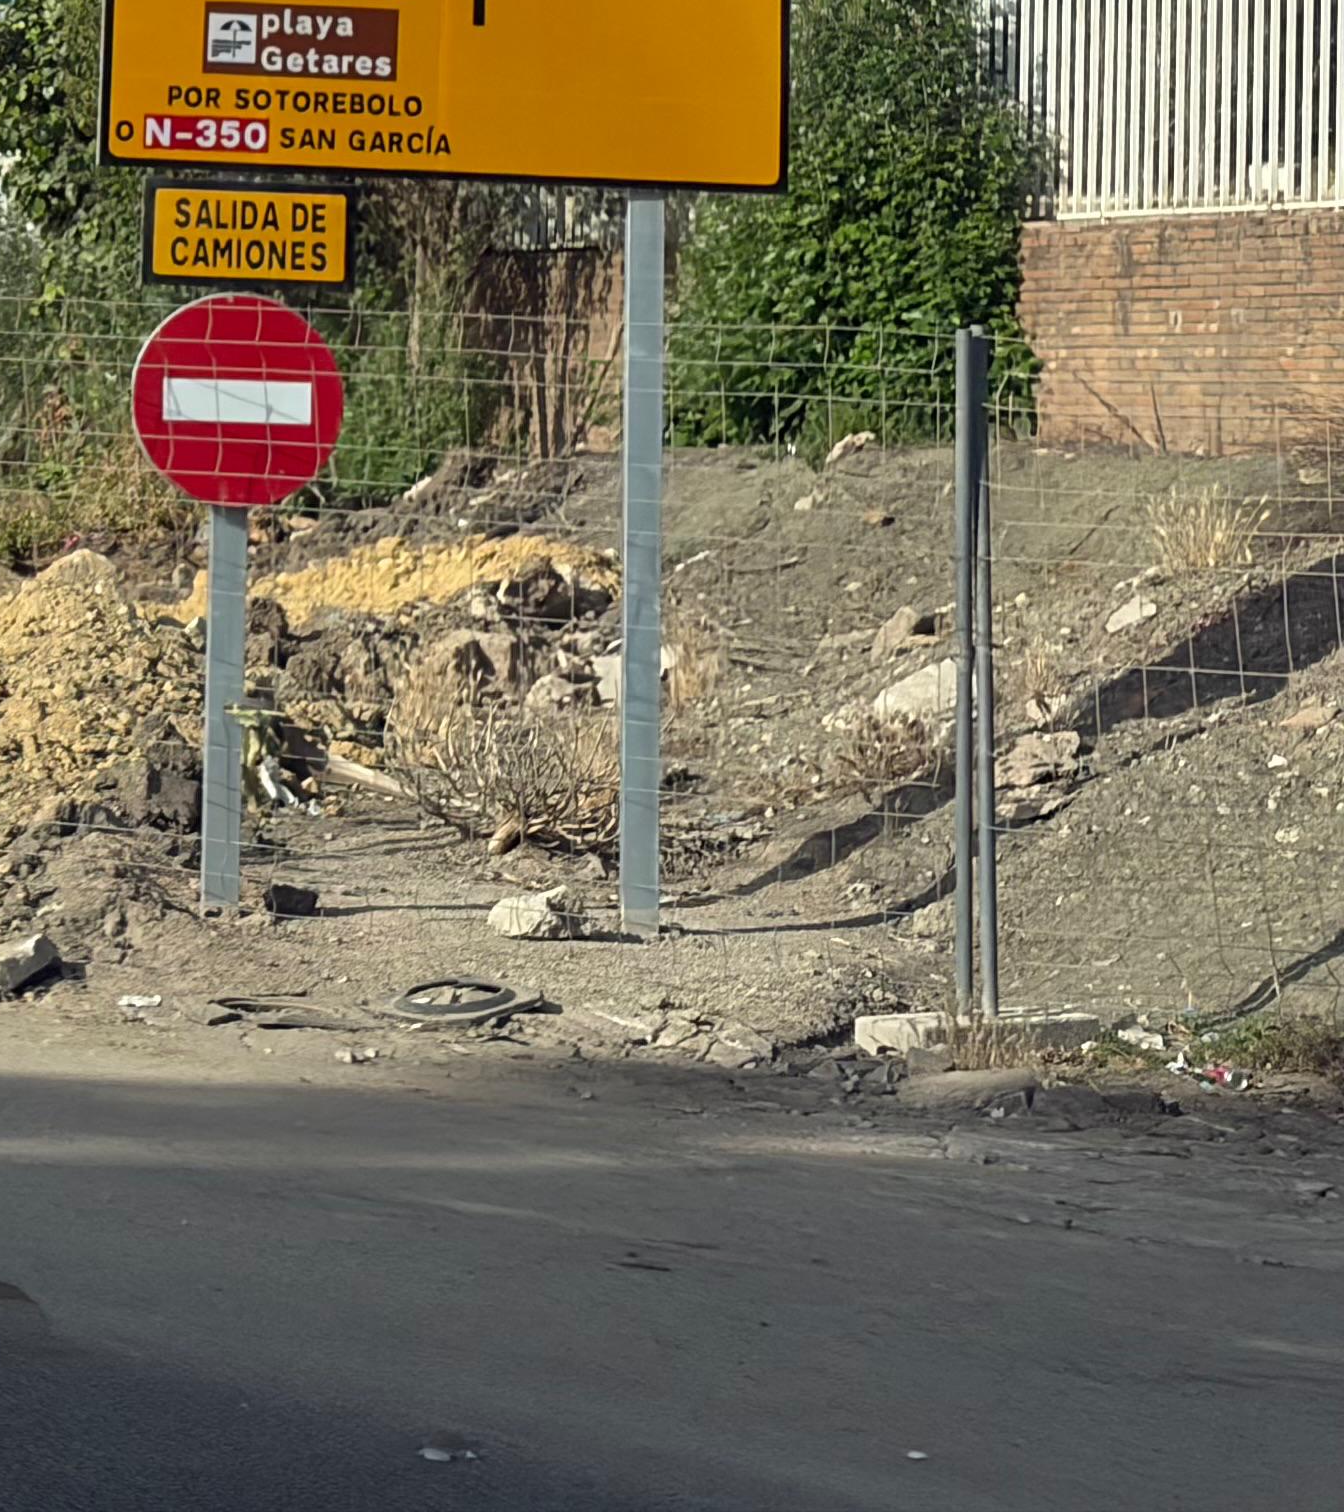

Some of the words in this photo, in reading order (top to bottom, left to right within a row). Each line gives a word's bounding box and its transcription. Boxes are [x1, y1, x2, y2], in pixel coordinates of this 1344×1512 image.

[263, 8, 354, 40] playa
[261, 46, 392, 78] Getares
[167, 85, 221, 109] POR
[234, 88, 423, 117] SOTOREBOLO
[115, 120, 135, 142] O
[144, 117, 268, 151] N-350
[279, 127, 336, 151] SAN
[348, 125, 452, 156] GARCÍA
[174, 197, 279, 231] SALIDA
[291, 202, 327, 233] DE
[170, 235, 328, 273] CAMIONES
